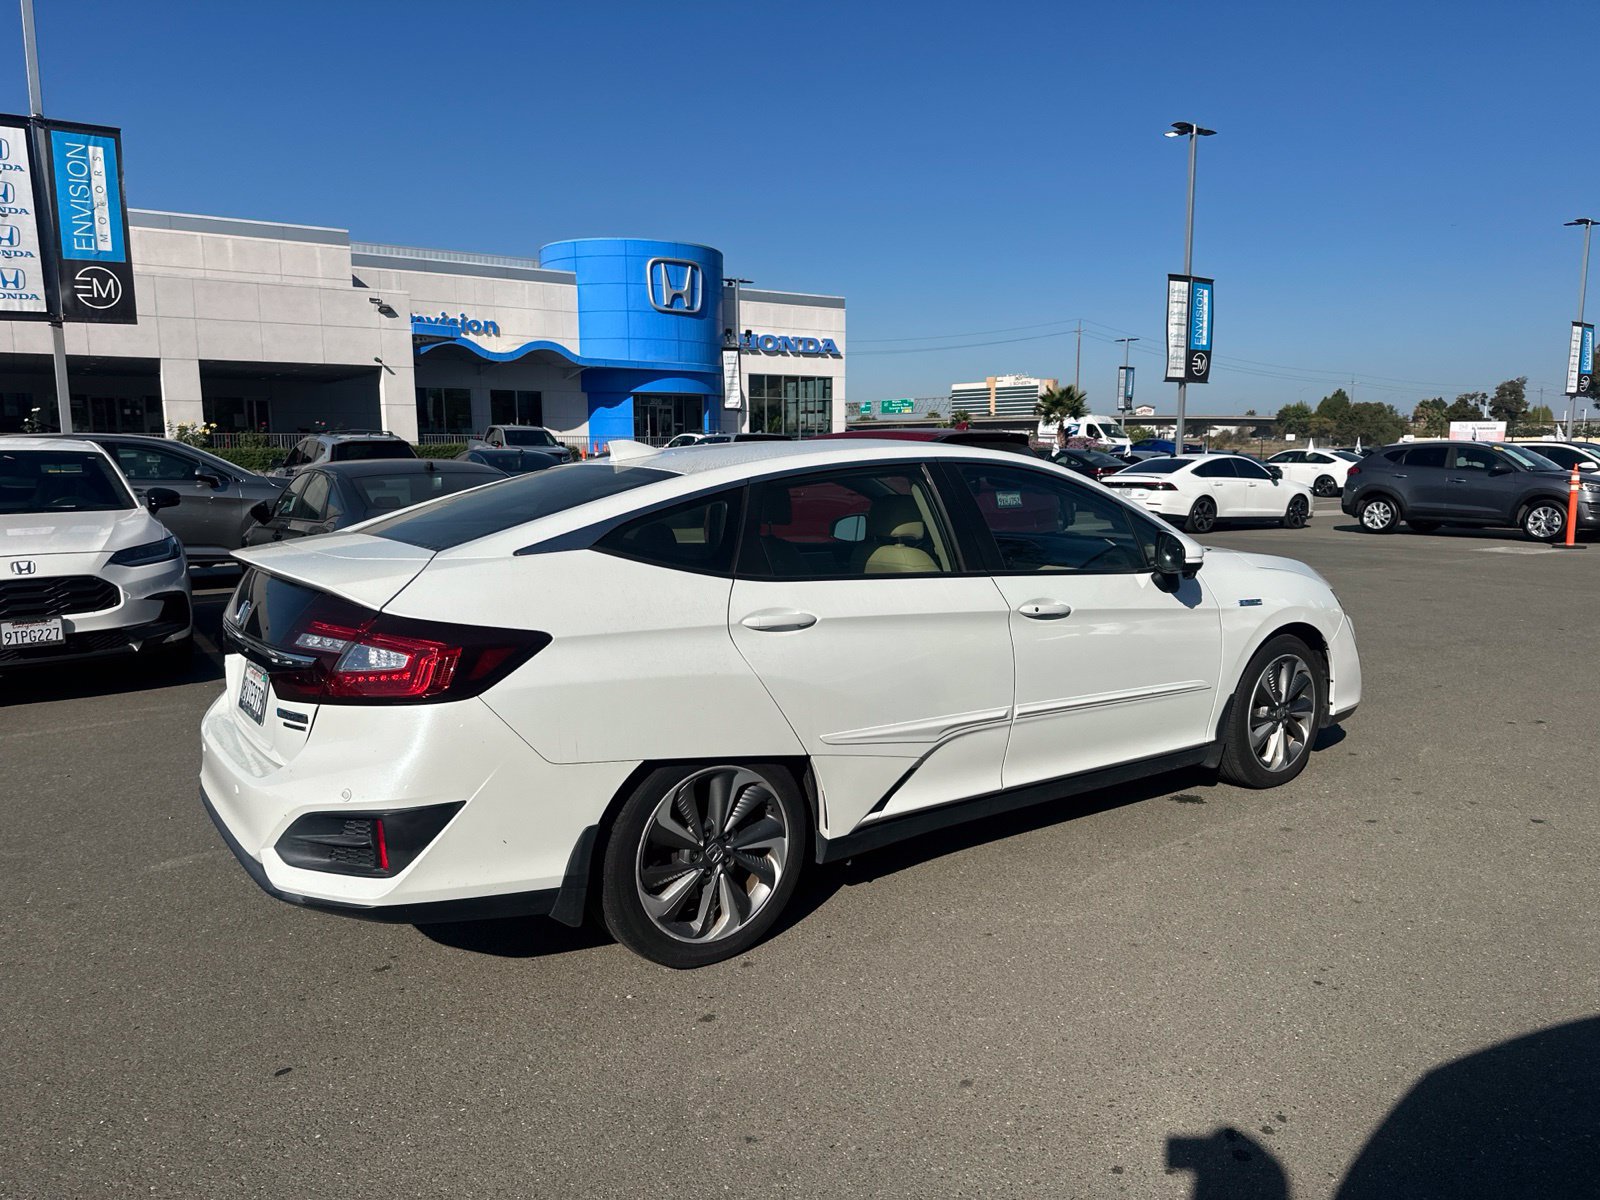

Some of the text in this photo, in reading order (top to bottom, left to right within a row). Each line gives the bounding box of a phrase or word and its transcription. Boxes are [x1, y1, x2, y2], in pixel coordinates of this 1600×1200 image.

[65, 142, 95, 251] ENVISION
[93, 155, 108, 243] MOTORS
[1194, 288, 1204, 345] ENVISION
[4, 627, 60, 645] 9TPG227
